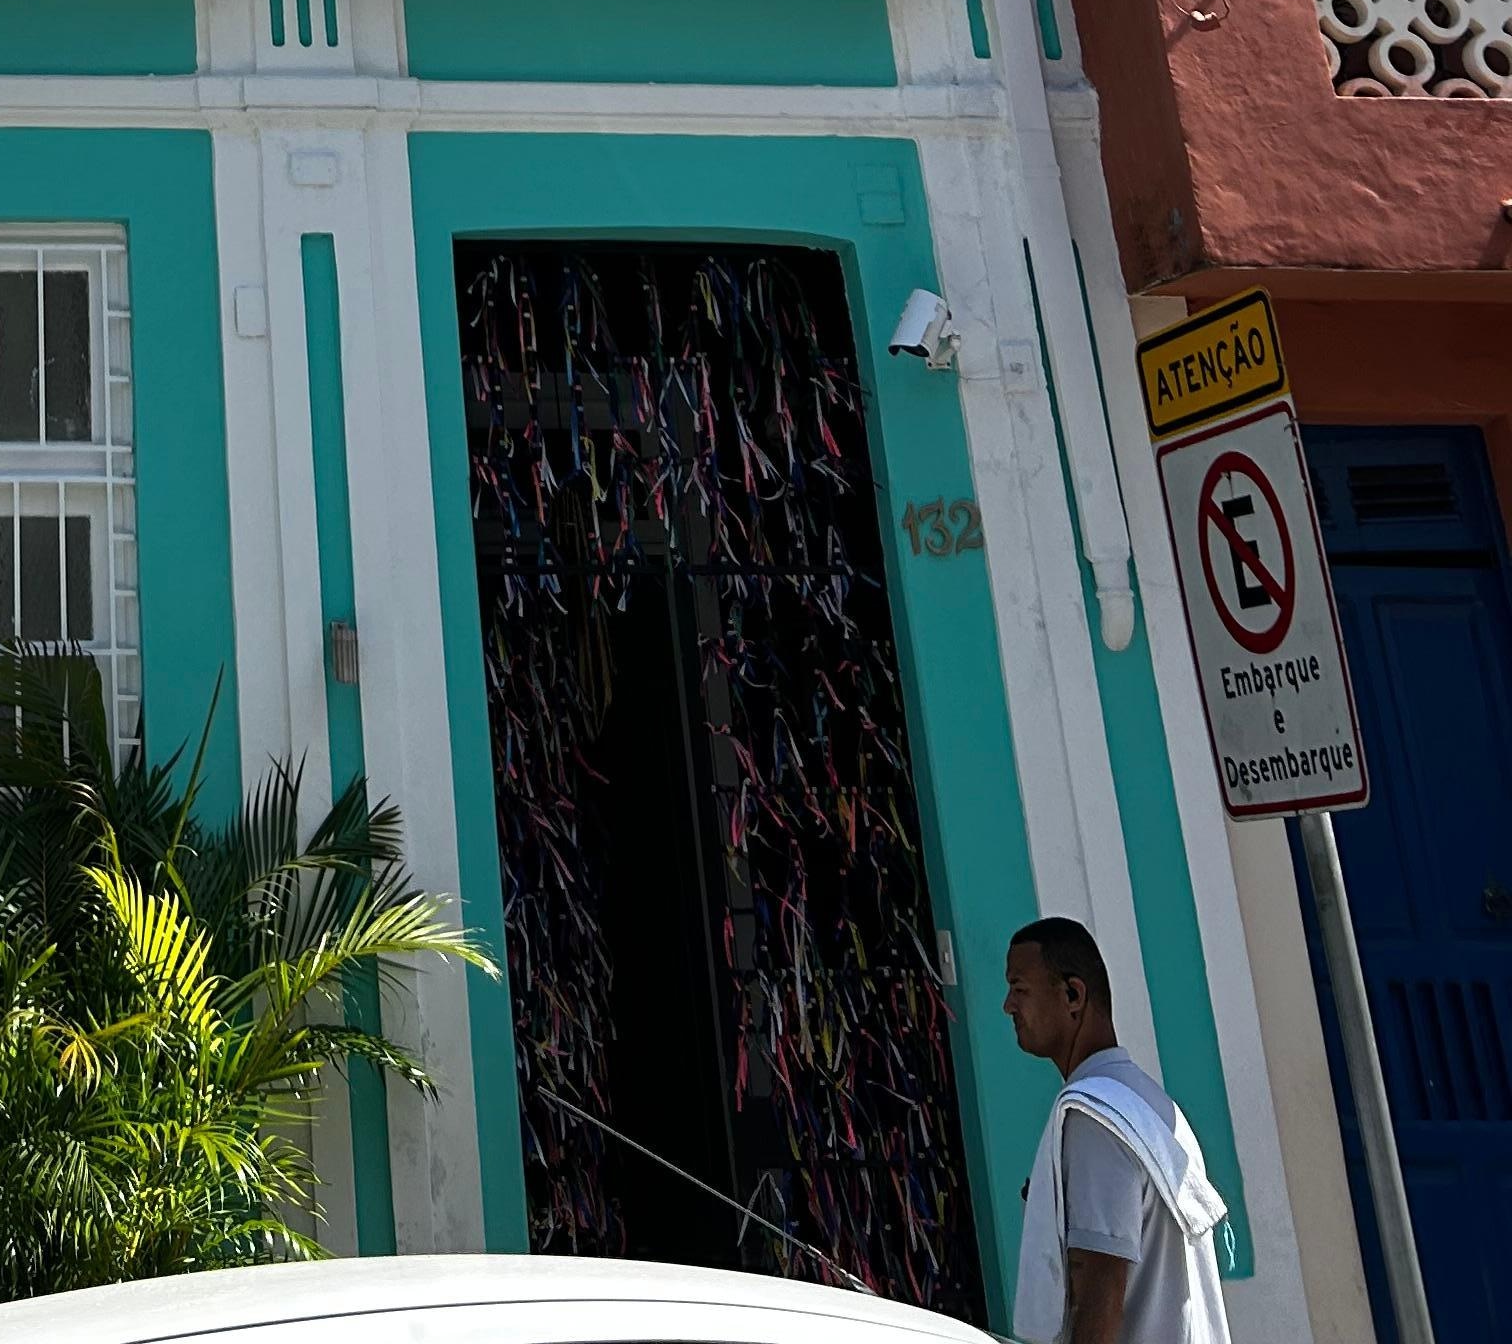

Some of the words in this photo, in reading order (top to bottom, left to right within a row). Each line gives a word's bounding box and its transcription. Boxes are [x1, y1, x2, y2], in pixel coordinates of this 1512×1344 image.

[1156, 322, 1266, 406] ATENÇÃO
[902, 497, 984, 556] 132
[1221, 654, 1321, 700] Embarque
[1273, 707, 1287, 734] e
[1224, 739, 1355, 789] Desembarque
